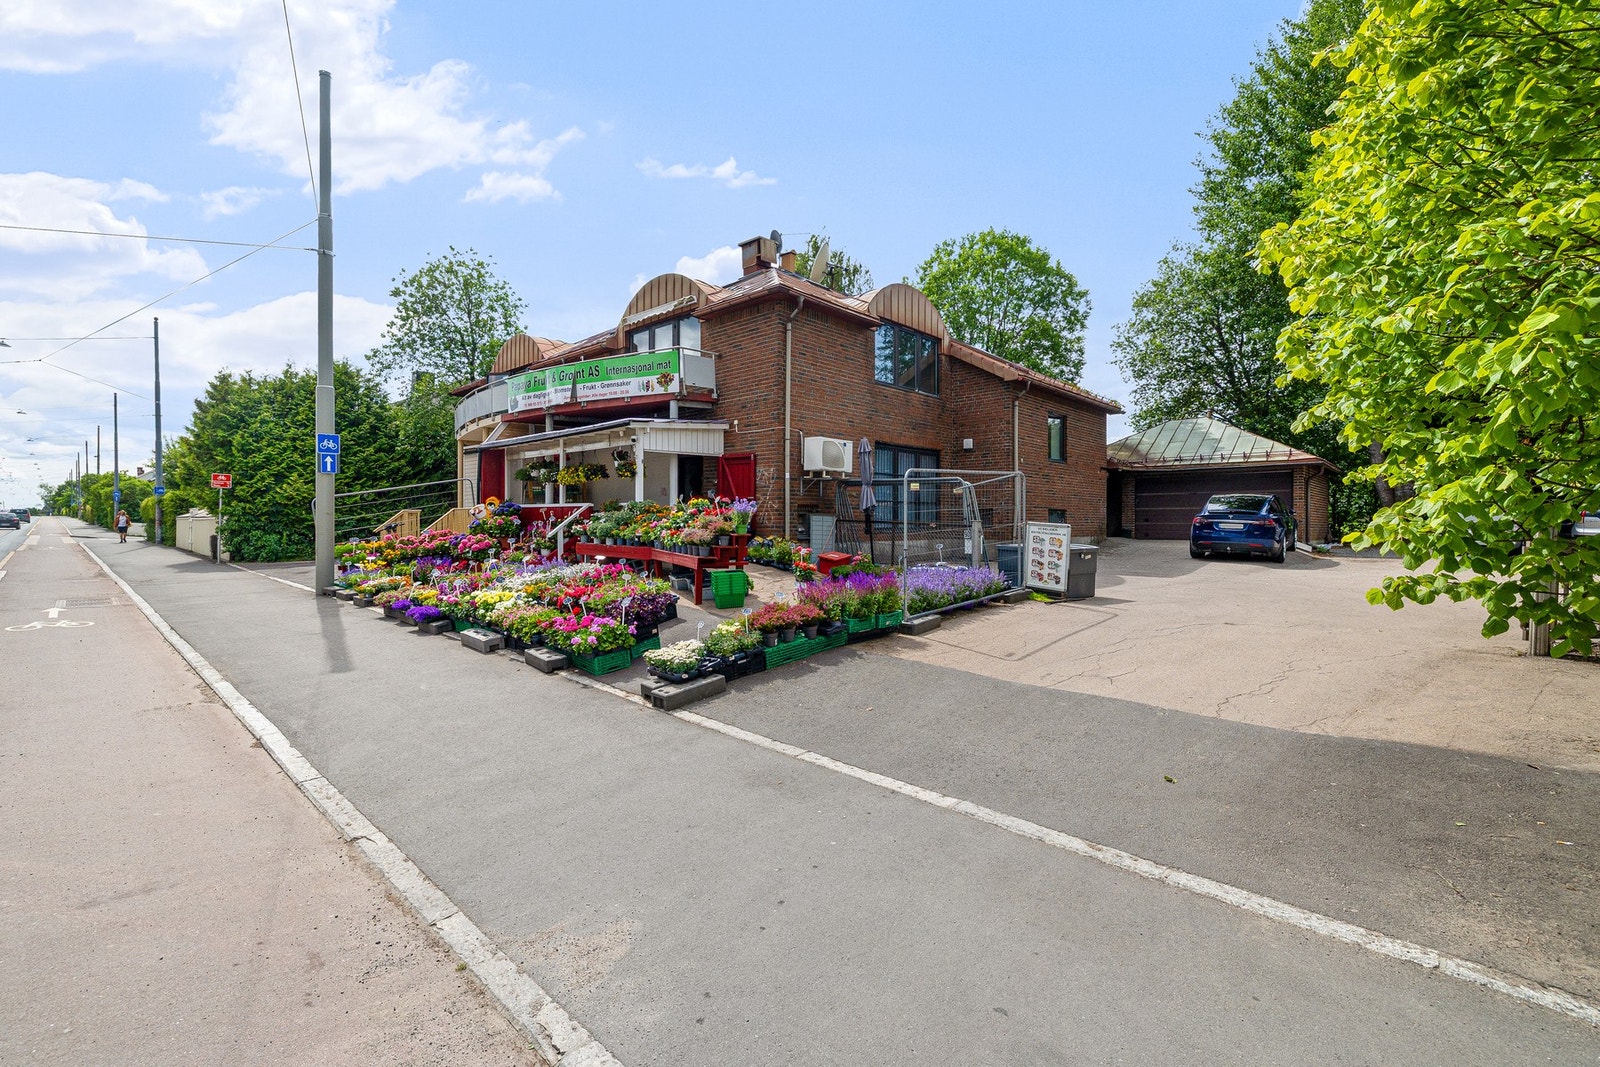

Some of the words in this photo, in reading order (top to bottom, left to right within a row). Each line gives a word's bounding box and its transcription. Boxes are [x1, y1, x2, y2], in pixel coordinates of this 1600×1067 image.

[588, 365, 600, 377] AS
[606, 361, 654, 375] Internasjonal
[657, 360, 671, 370] mat
